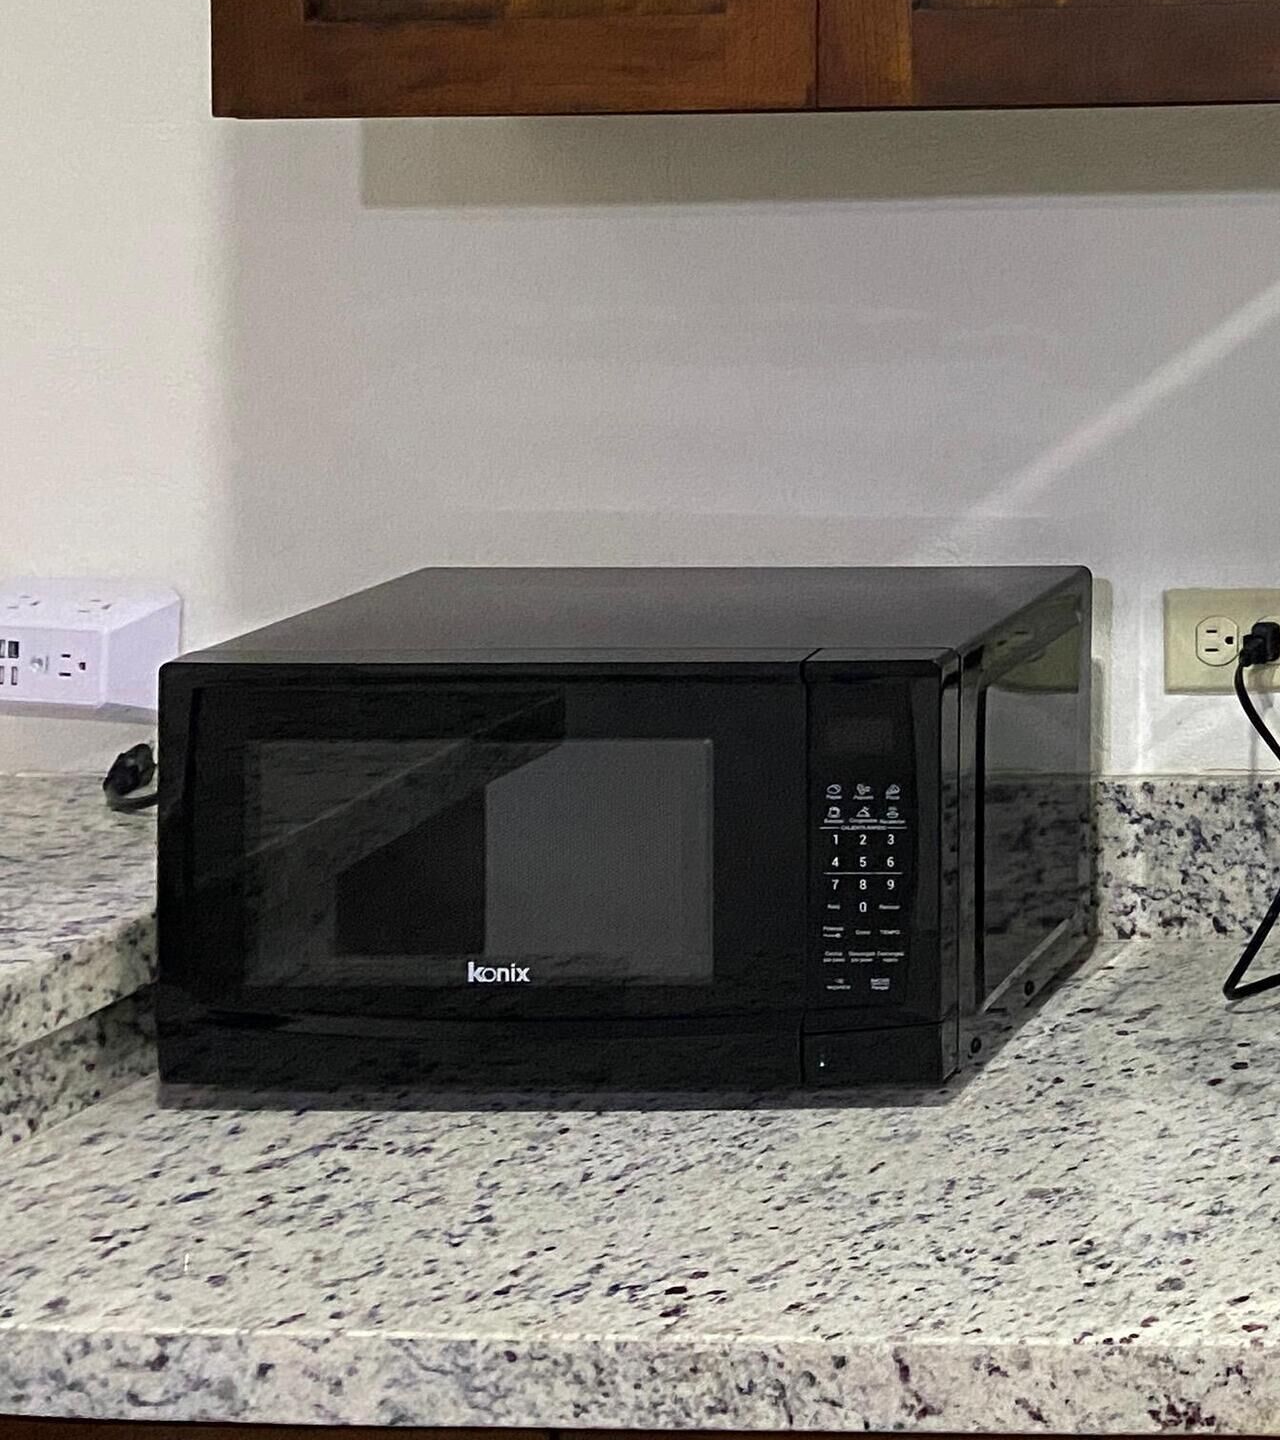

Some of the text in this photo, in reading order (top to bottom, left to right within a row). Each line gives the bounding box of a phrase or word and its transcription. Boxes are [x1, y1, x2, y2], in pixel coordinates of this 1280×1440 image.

[833, 833, 895, 846] 1 2 3
[831, 856, 895, 868] 4 5 6
[831, 879, 895, 891] 7 8 9
[859, 901, 868, 913] 0
